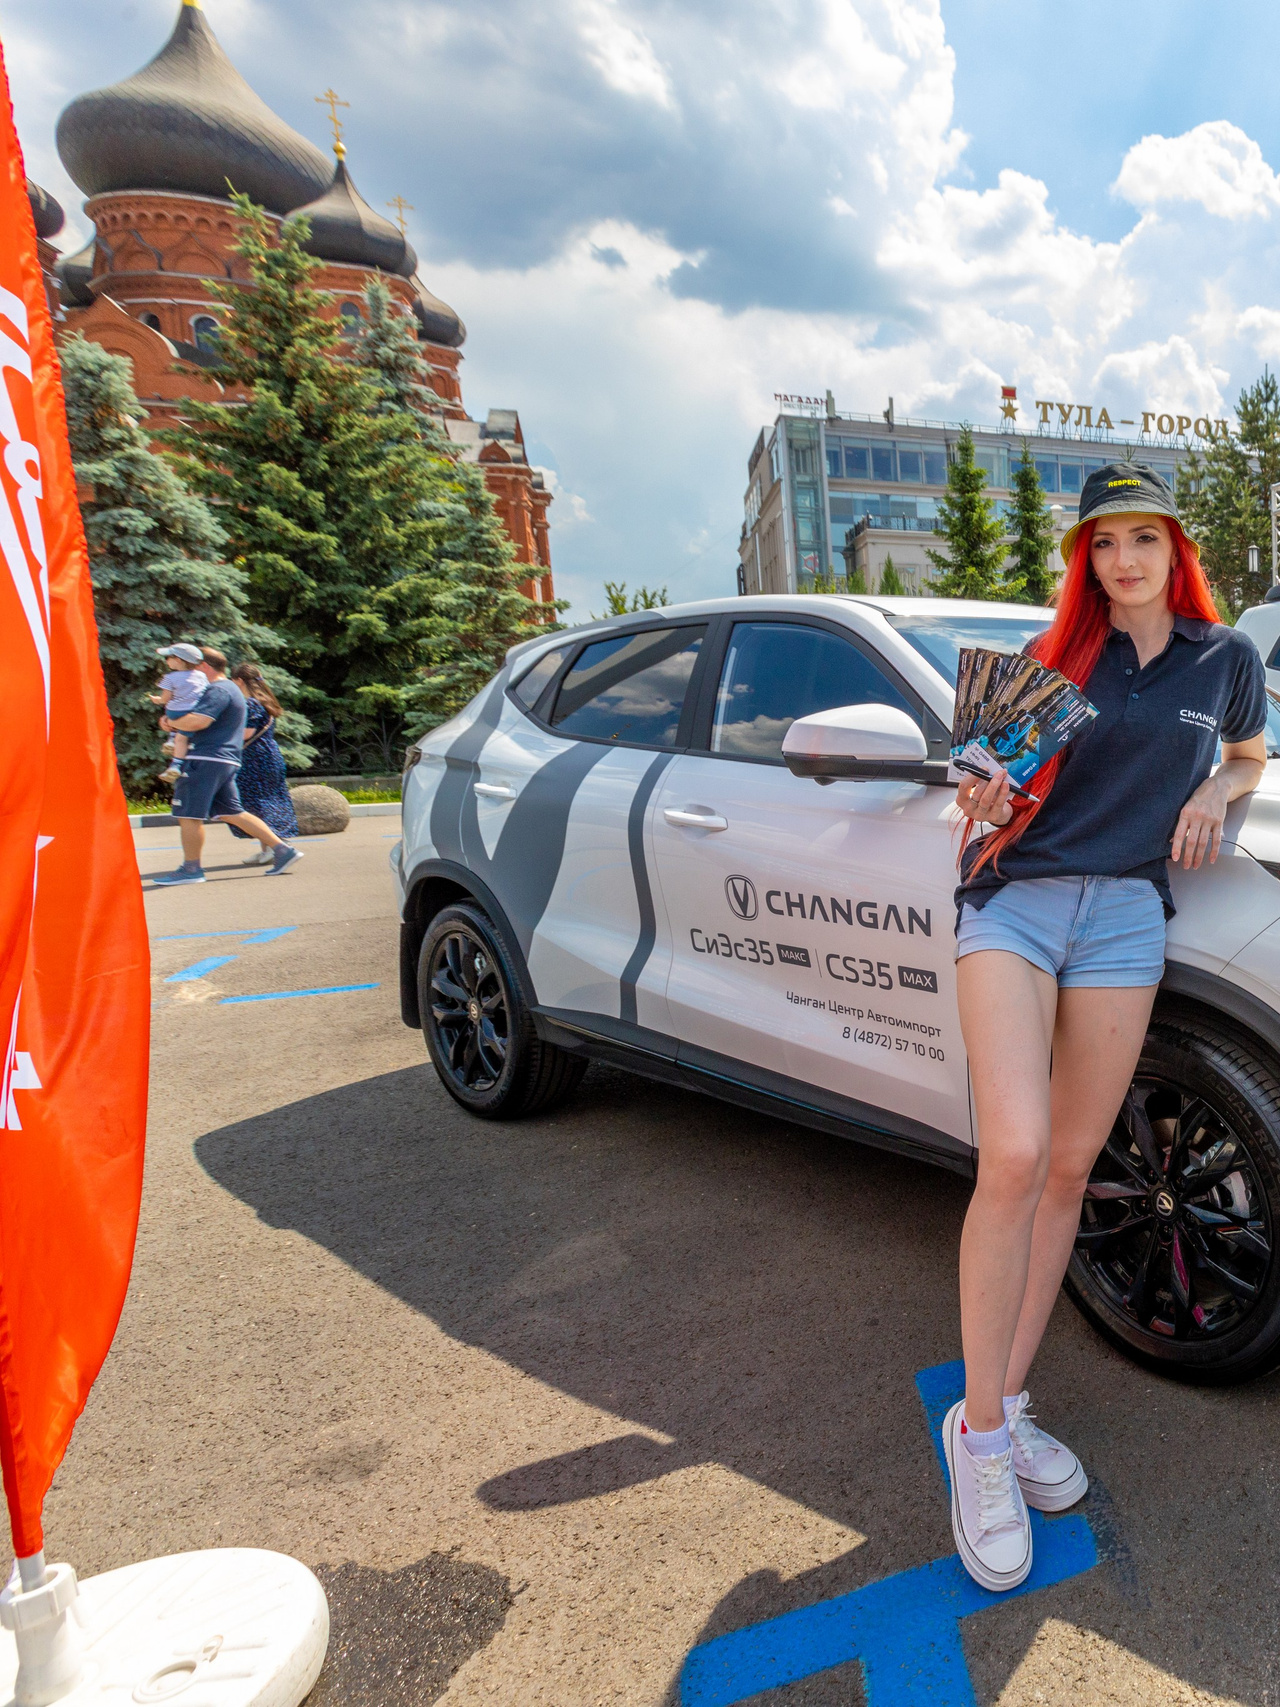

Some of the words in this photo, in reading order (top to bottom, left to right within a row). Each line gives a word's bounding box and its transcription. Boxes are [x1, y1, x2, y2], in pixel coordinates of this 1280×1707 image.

[774, 393, 829, 405] МАГАДАН
[1035, 400, 1115, 430] ТУЛА
[1108, 479, 1141, 488] RESPECT
[765, 889, 931, 937] CHANGAN
[690, 928, 774, 965] СиЭс35
[780, 948, 807, 962] МАКС
[825, 953, 893, 990] CS35
[902, 971, 933, 988] MAX
[786, 990, 825, 1009] Чанган
[828, 1000, 864, 1019] Центр
[867, 1009, 941, 1037] Автоимпорт
[842, 1026, 850, 1039] 8
[853, 1028, 892, 1050] (4872)
[895, 1038, 909, 1051] 57
[912, 1042, 925, 1056] 10
[928, 1047, 945, 1061] 00
